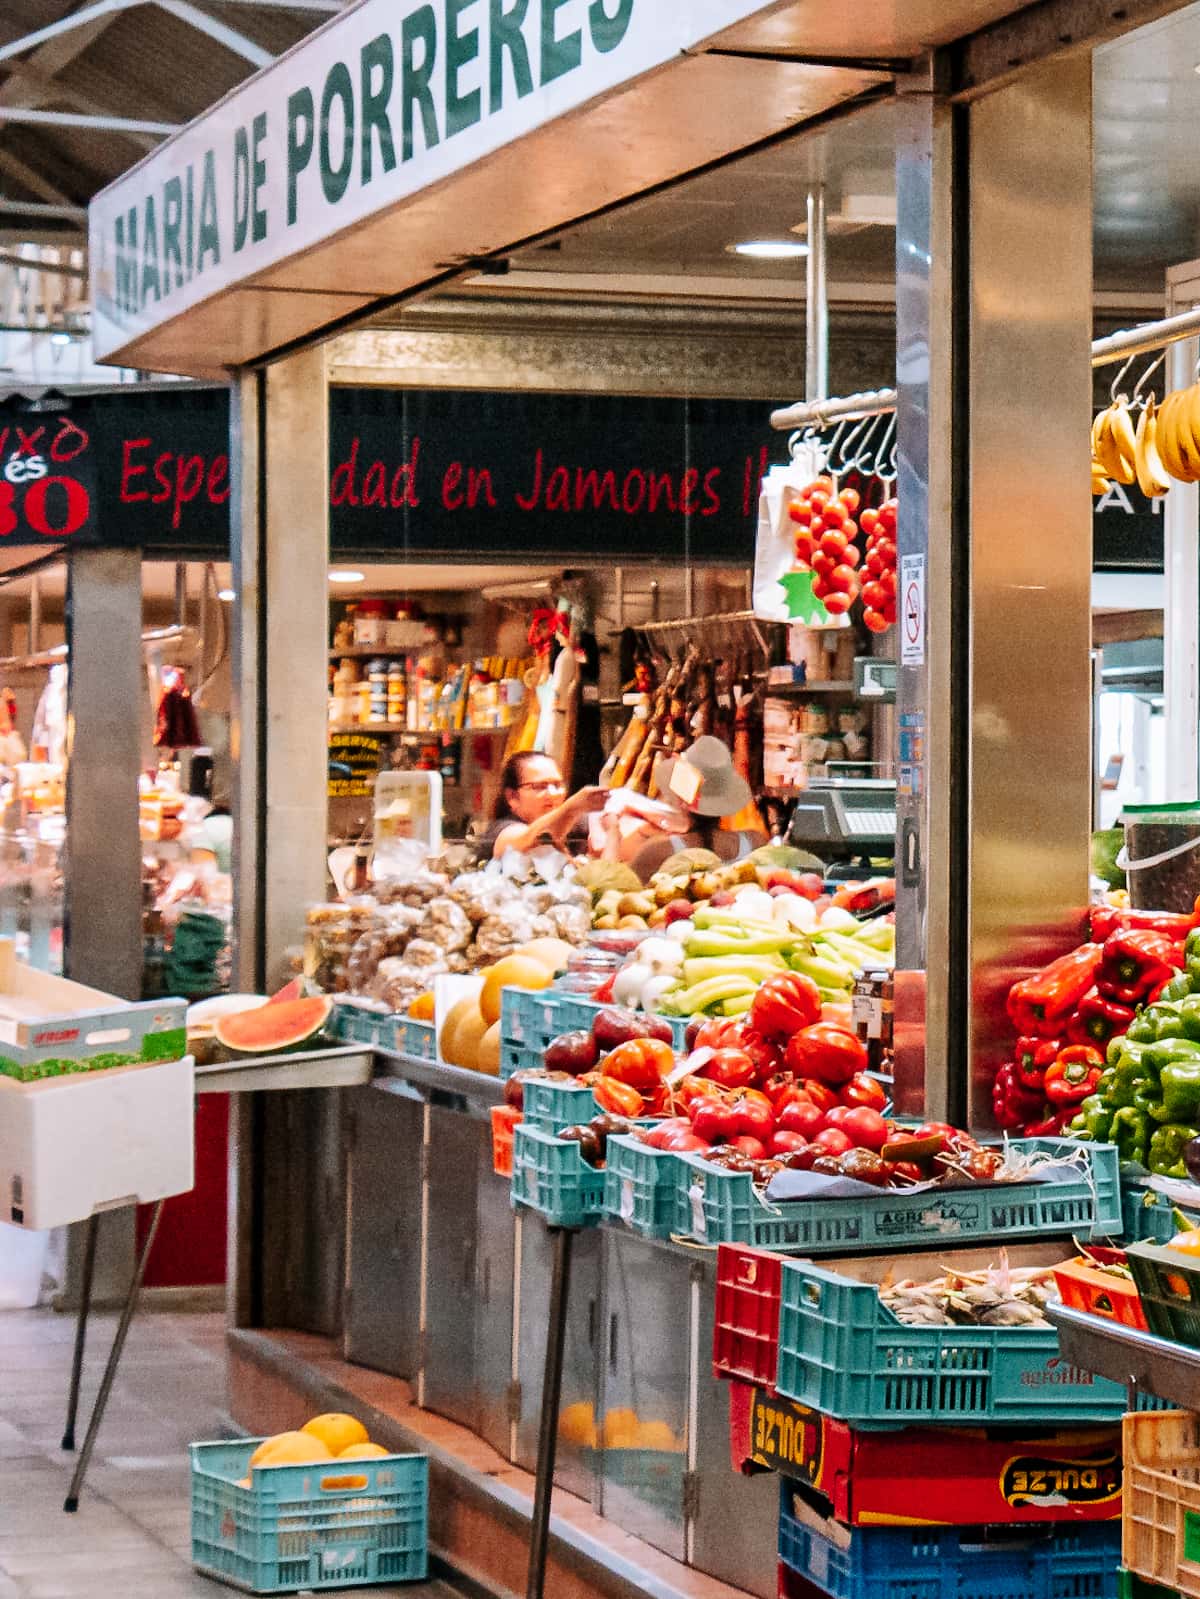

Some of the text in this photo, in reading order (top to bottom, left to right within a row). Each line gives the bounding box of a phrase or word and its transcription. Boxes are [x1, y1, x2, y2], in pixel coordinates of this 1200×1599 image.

[114, 149, 220, 315] MARIA
[233, 112, 268, 254] DE
[442, 461, 496, 511] en
[515, 448, 722, 516] Jamones
[756, 1403, 805, 1466] DULZE
[1011, 1468, 1098, 1492] DULZE
